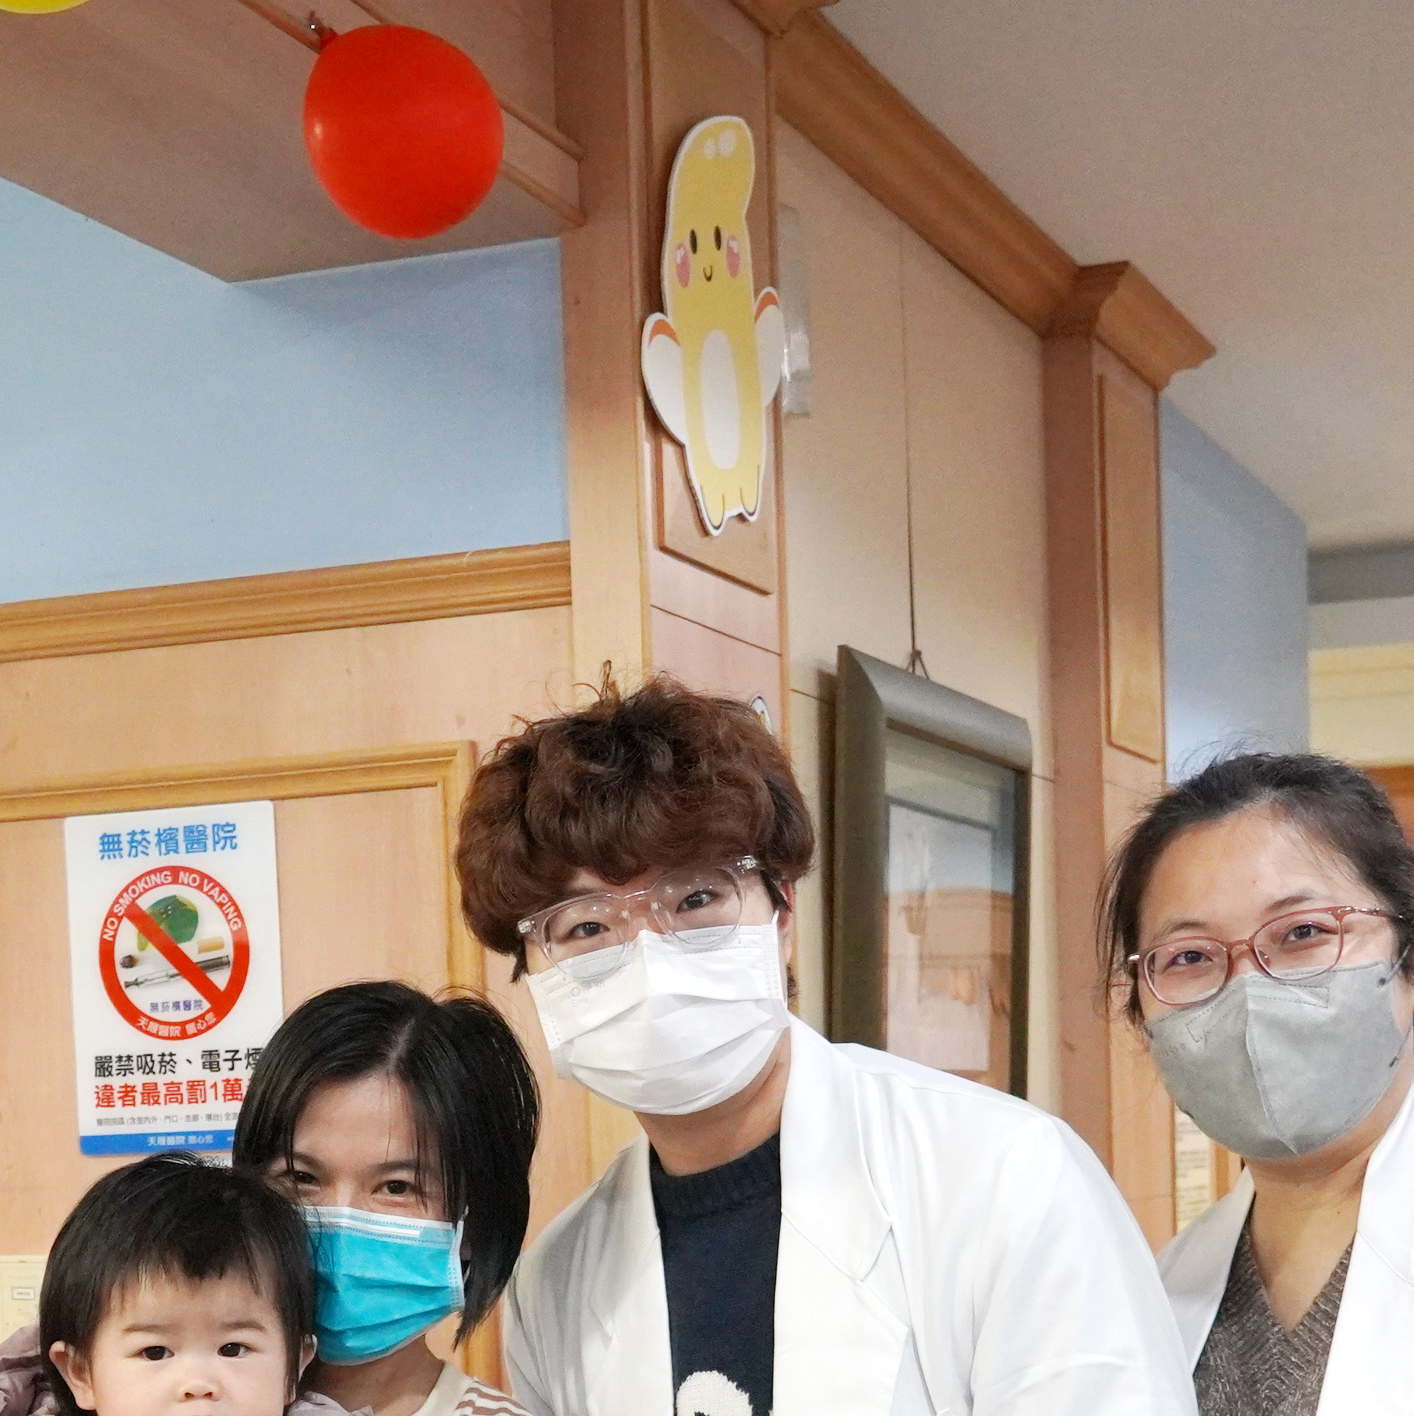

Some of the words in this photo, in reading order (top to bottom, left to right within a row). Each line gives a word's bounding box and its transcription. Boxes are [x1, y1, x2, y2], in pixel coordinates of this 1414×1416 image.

[99, 822, 238, 861] 無菸檳醫院
[102, 917, 118, 942] NO
[113, 871, 172, 917] SMOKING
[179, 871, 200, 886] NO
[203, 878, 242, 932] VAPING
[149, 999, 205, 1014] 無菸檳醫院
[94, 1078, 251, 1110] 違者最高罰1萬
